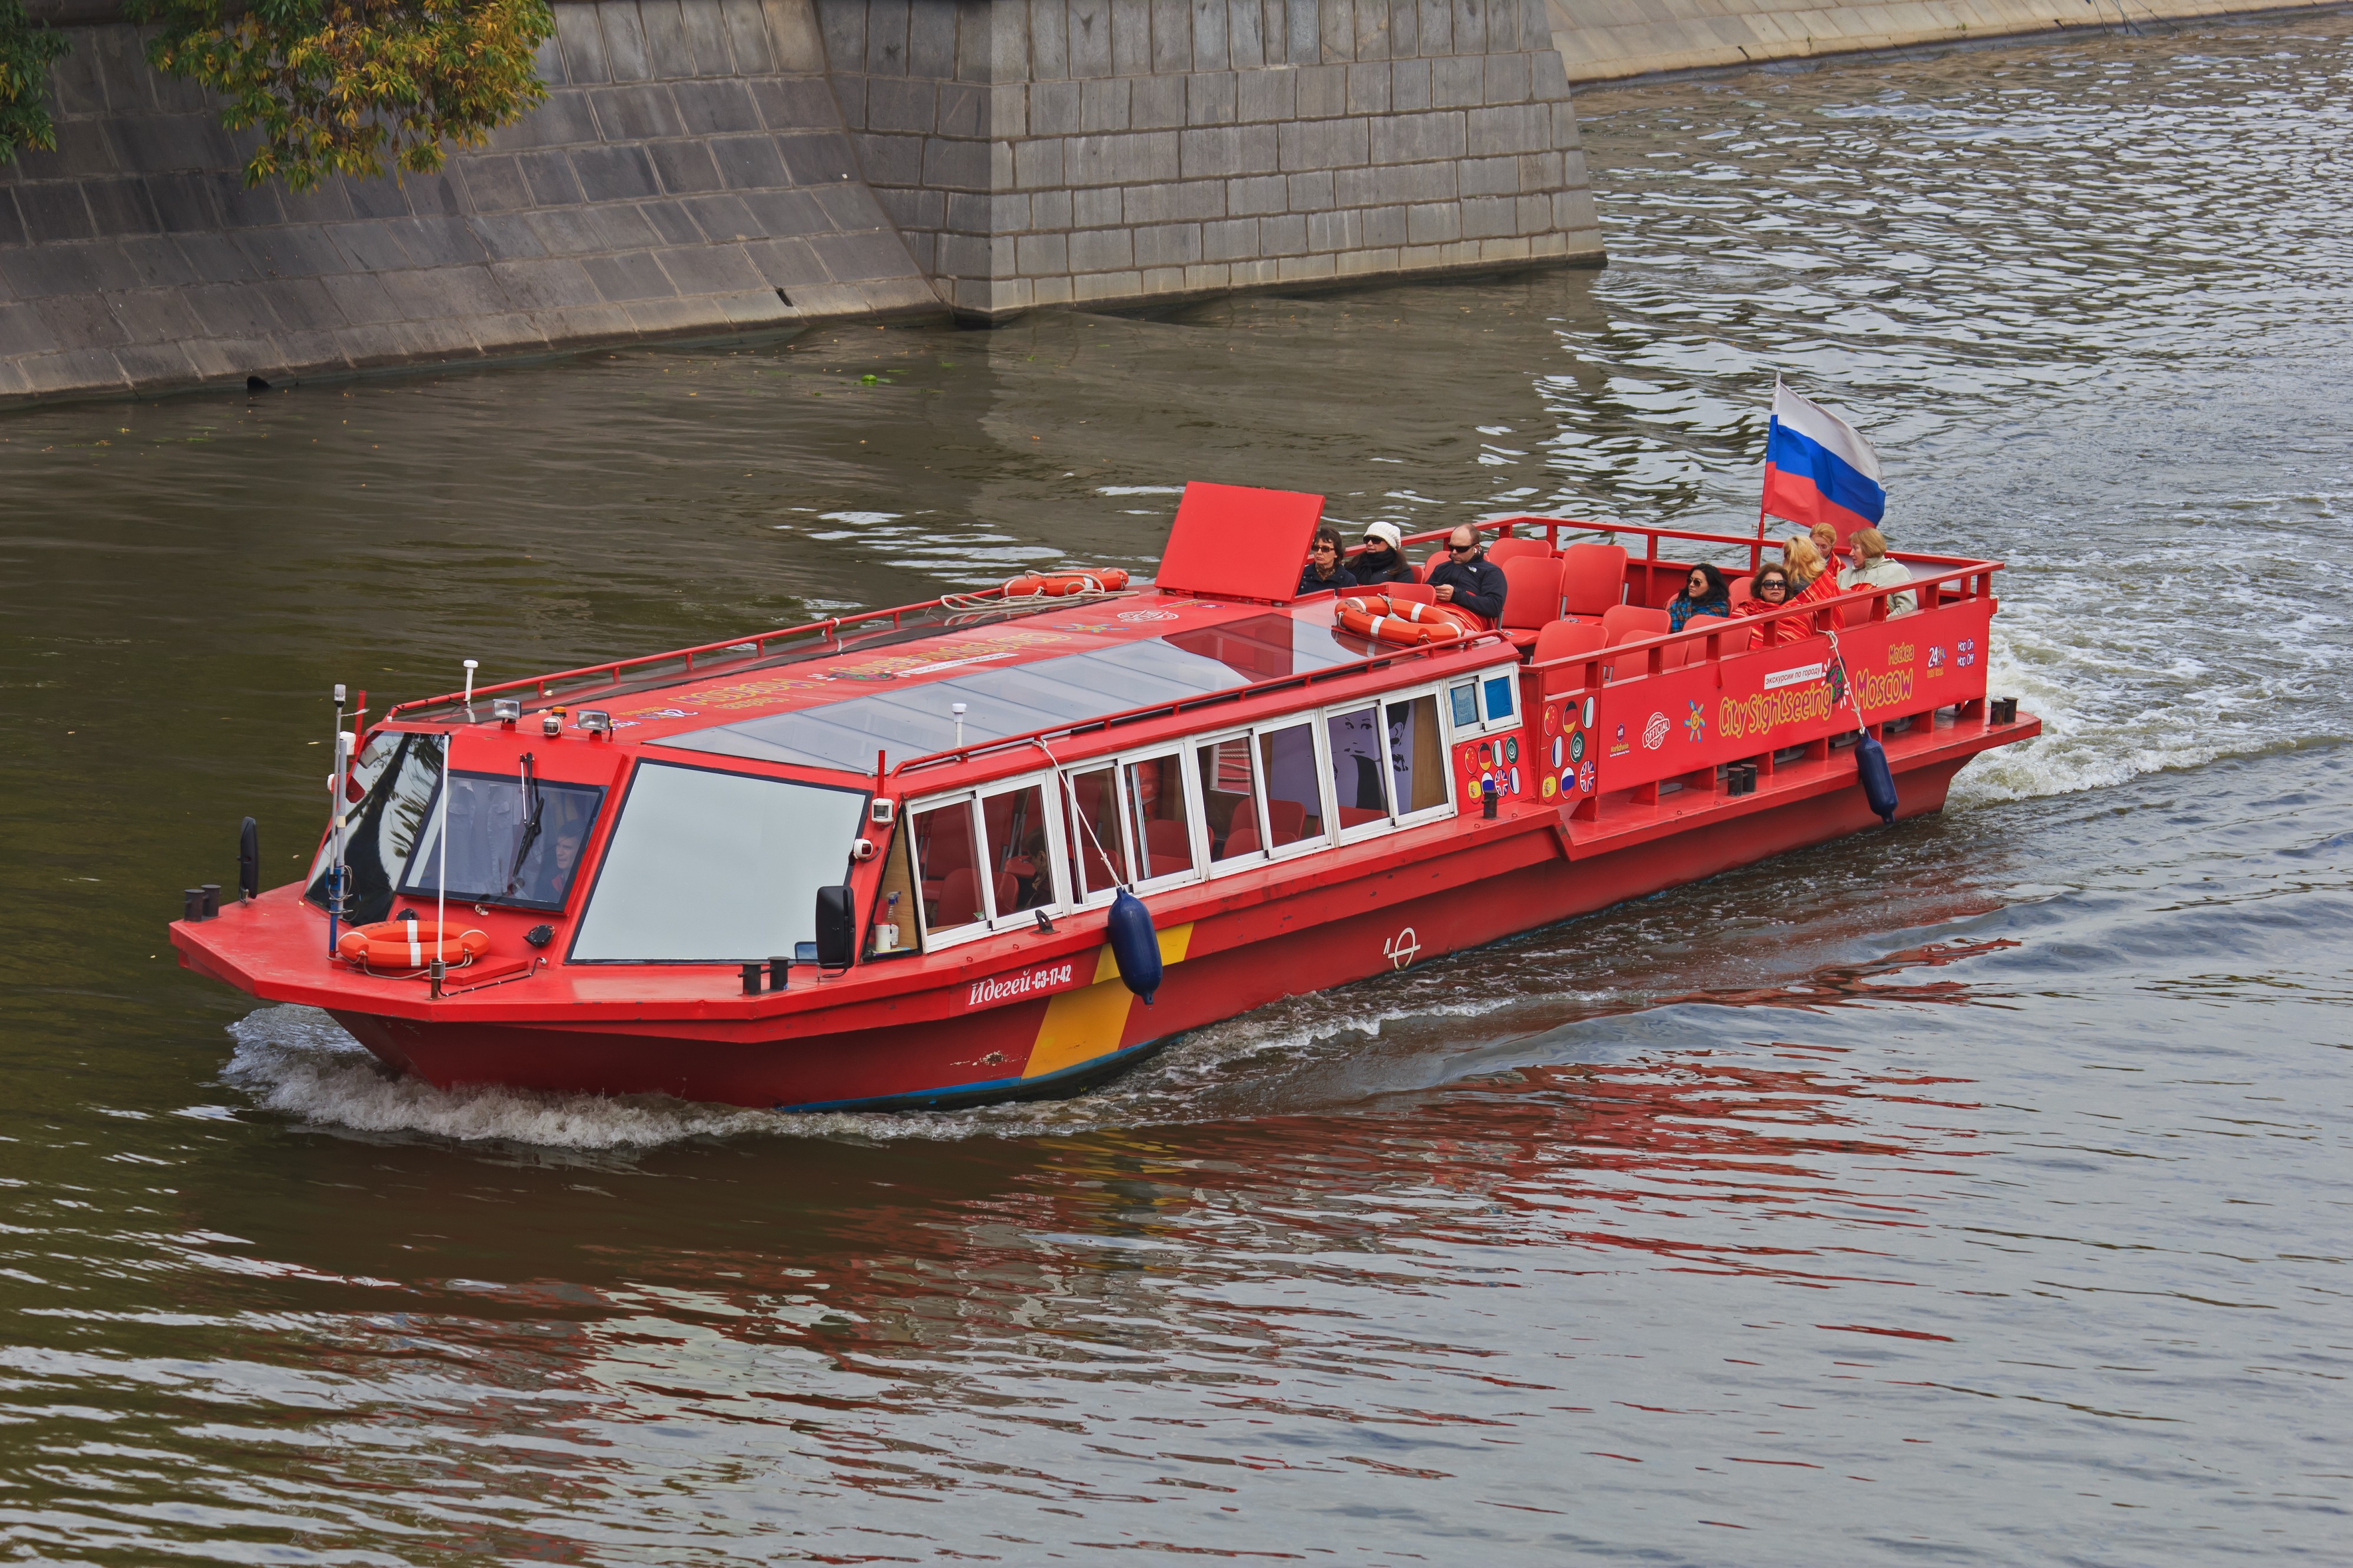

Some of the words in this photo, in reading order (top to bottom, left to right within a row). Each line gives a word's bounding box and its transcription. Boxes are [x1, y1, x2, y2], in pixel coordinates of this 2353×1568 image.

[1958, 641, 1967, 653] Hop
[1967, 638, 1974, 650] On
[1957, 655, 1965, 668] Hop
[1765, 673, 1794, 685] экскурсии
[1795, 671, 1802, 680] по
[1802, 666, 1821, 677] городу
[1719, 696, 1748, 739] City
[1748, 682, 1833, 735] Sightseeing
[1645, 721, 1668, 743] OFFICIAL
[1652, 734, 1663, 746] TOUR
